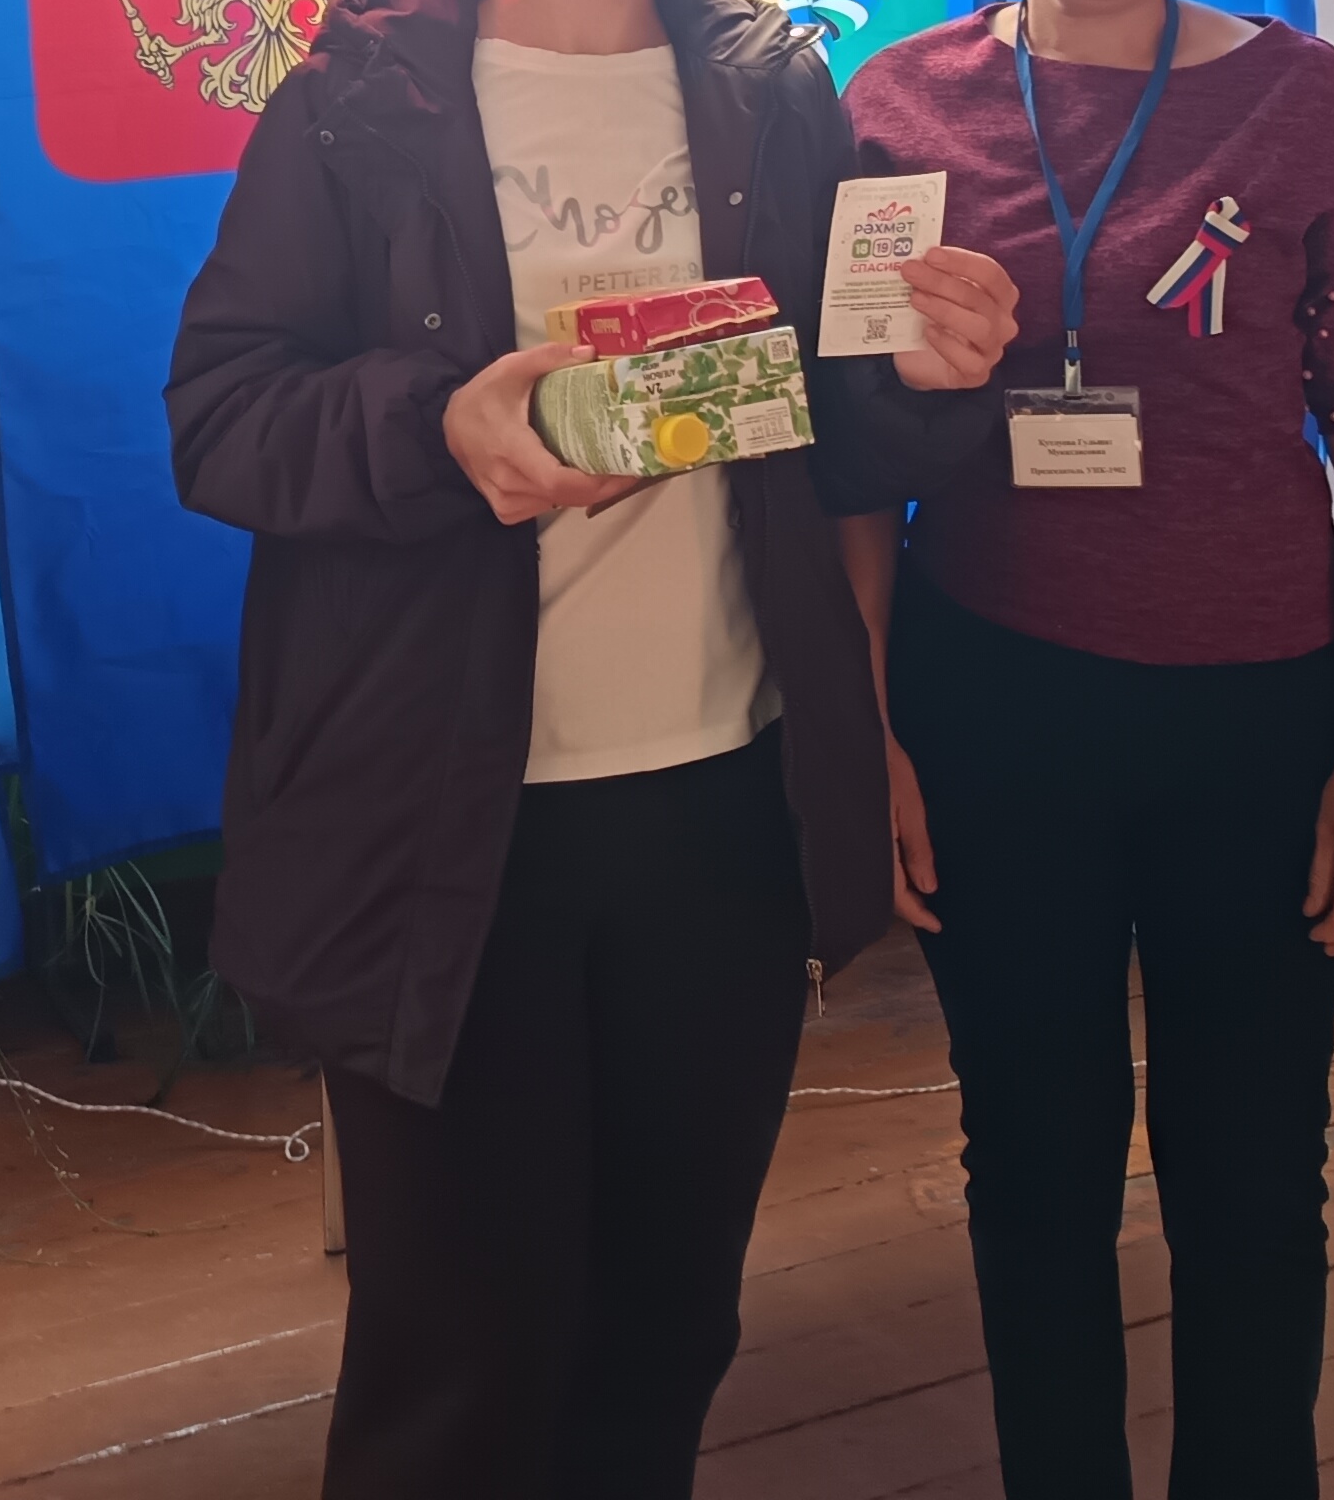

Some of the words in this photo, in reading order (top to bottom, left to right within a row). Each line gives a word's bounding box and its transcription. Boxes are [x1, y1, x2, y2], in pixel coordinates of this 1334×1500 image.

[853, 221, 915, 235] РӘХМӘТ
[855, 243, 869, 255] 18
[876, 242, 889, 254] 19
[894, 241, 911, 253] 20
[850, 262, 902, 274] СПАСИБ
[577, 268, 664, 293] PETTER
